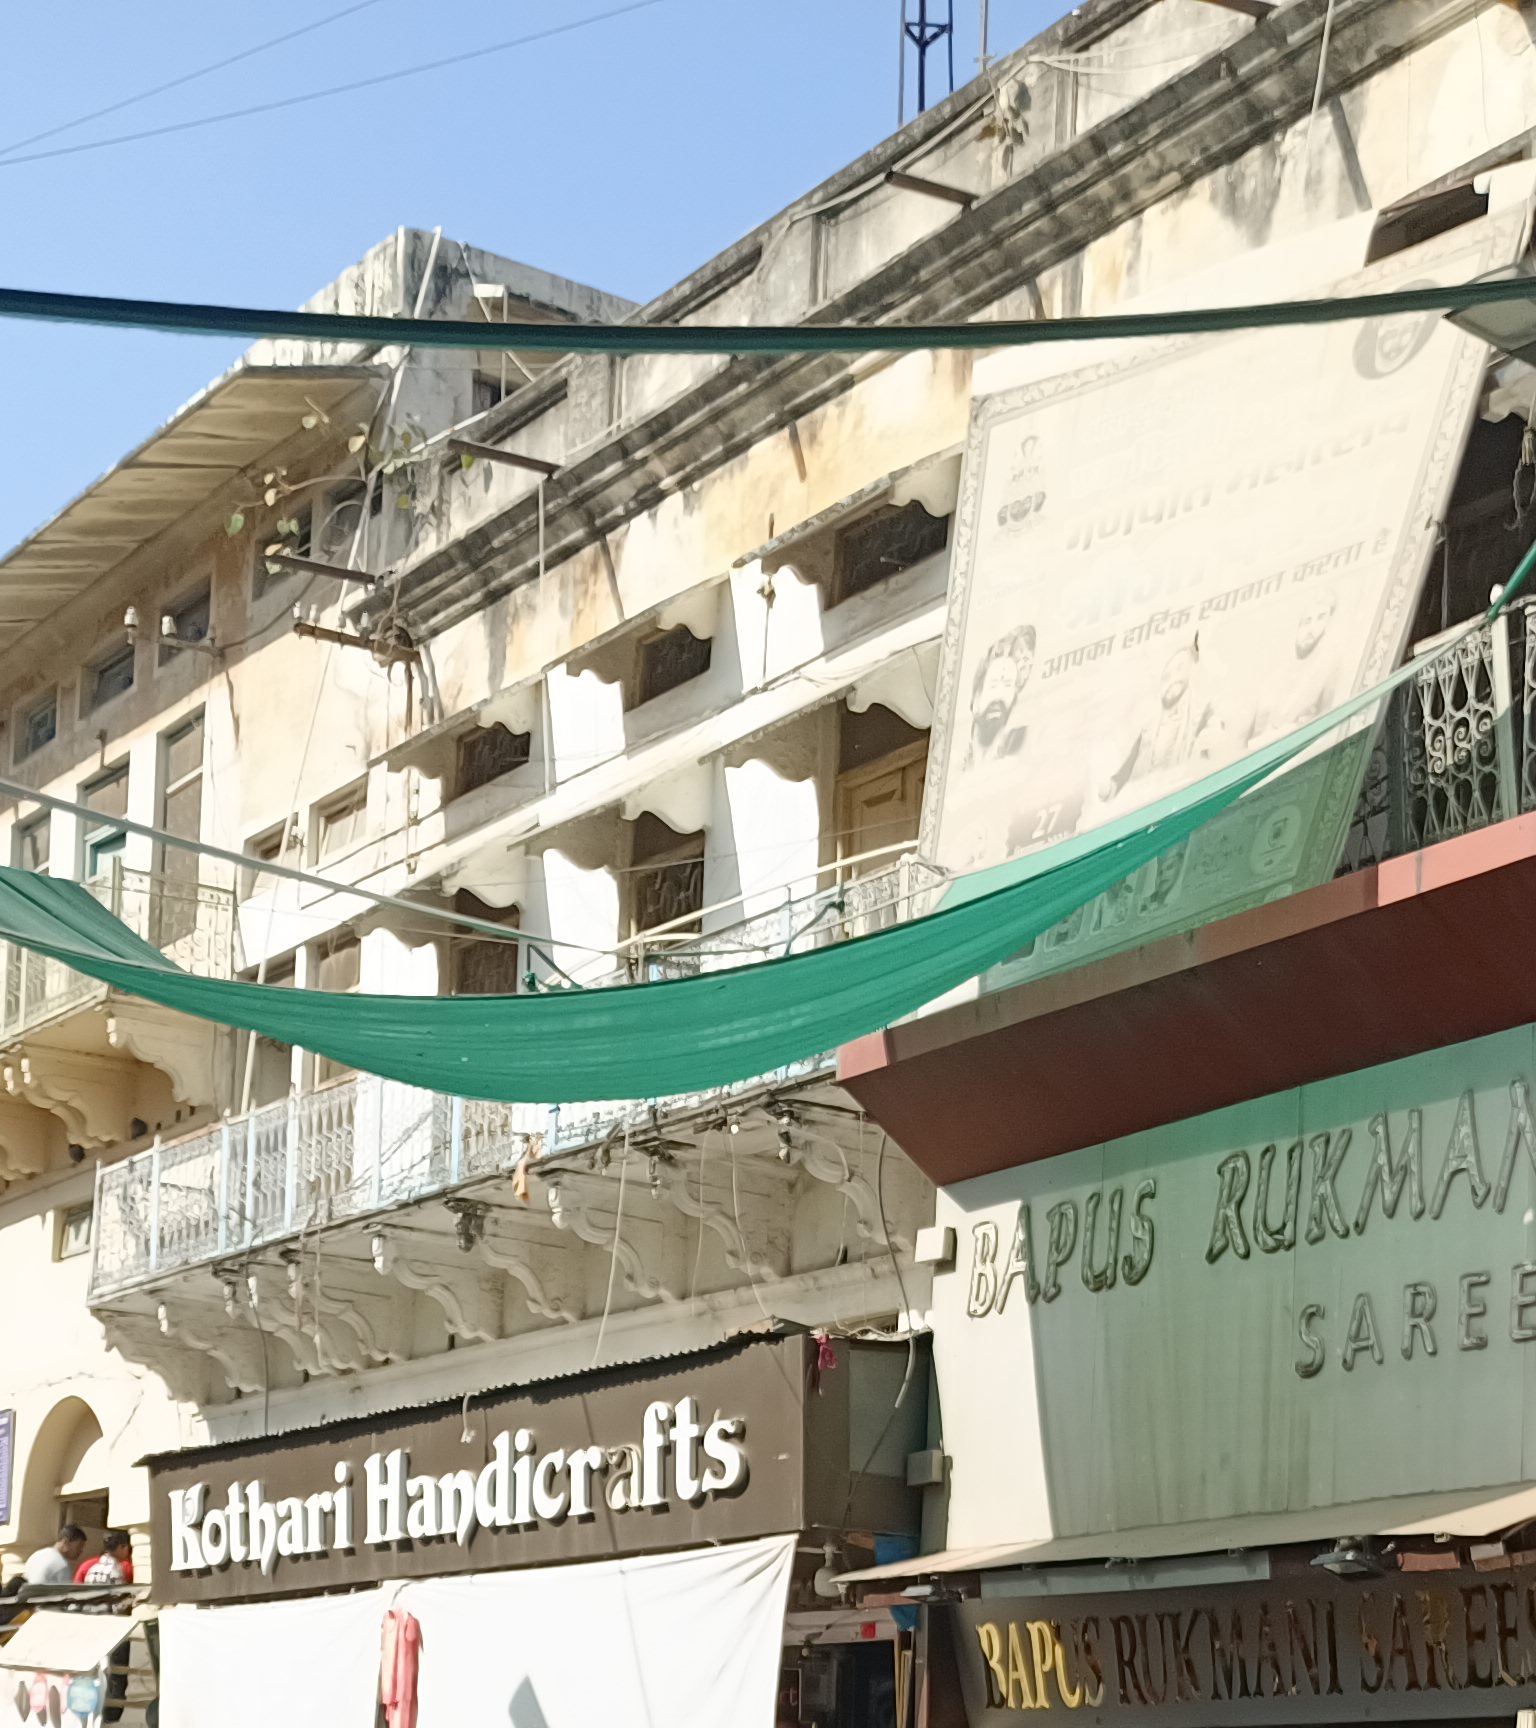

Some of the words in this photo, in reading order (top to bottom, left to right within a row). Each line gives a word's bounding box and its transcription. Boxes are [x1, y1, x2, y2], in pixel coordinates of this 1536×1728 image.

[967, 1178, 1158, 1320] BAPUS
[167, 1459, 354, 1575] Kothari
[364, 1396, 748, 1548] Handicrafts
[975, 1616, 1105, 1711] BAPUS
[1115, 1600, 1345, 1706] RUKMANI
